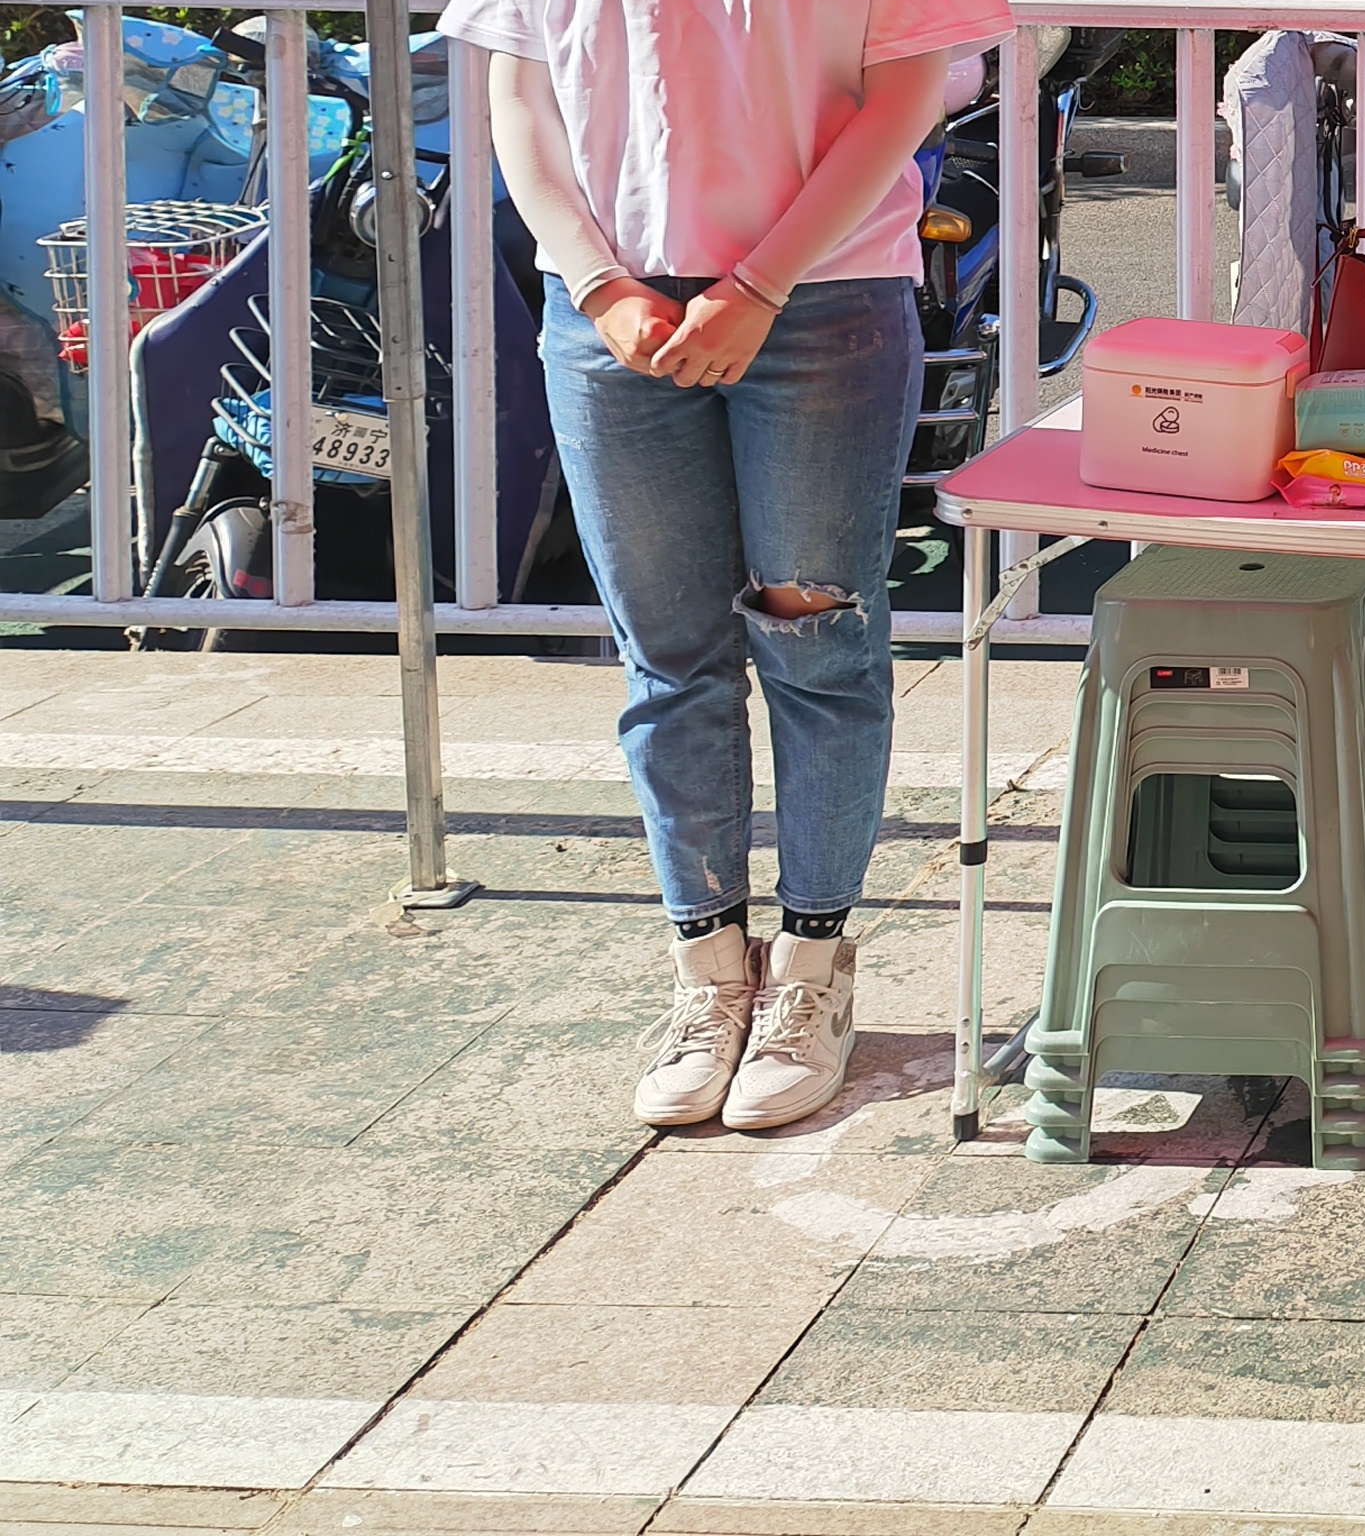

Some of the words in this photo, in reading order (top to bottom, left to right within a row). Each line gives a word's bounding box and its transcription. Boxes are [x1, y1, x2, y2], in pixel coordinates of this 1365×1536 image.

[331, 422, 388, 444] 济宁
[312, 436, 390, 468] 48933
[1142, 446, 1171, 455] Medicine
